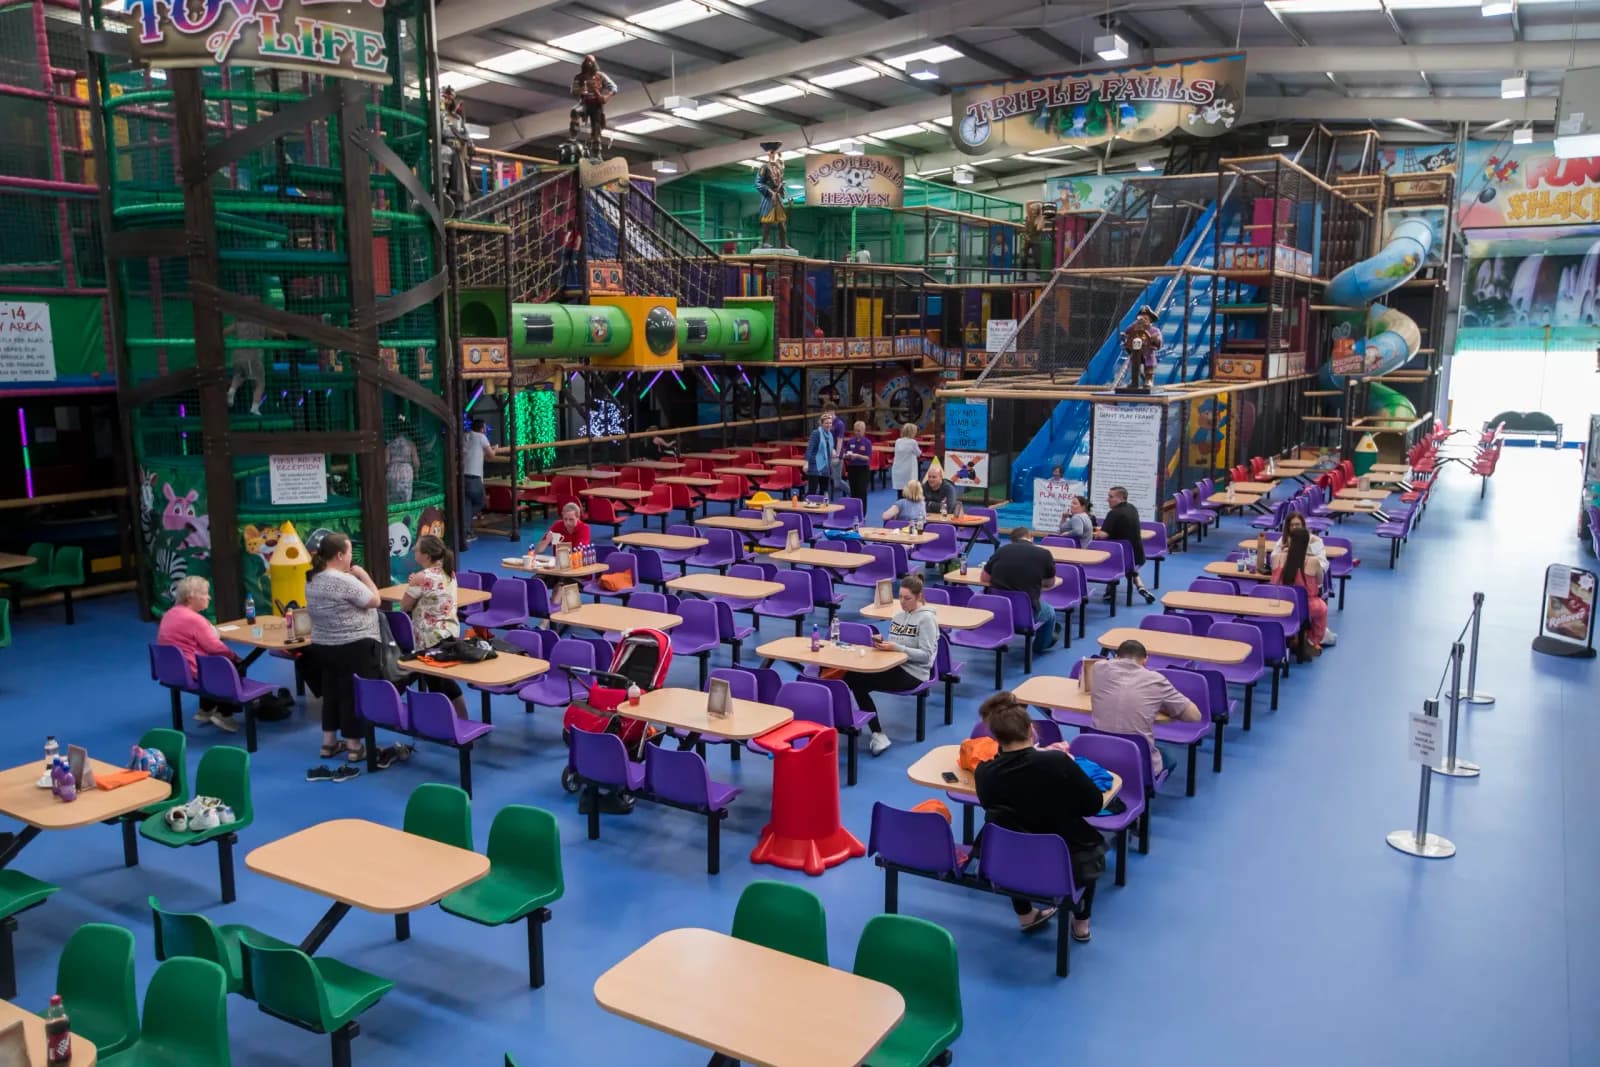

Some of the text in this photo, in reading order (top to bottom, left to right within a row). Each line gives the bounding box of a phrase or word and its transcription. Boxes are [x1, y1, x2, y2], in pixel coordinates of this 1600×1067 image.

[206, 16, 255, 62] of
[256, 12, 389, 73] LIFE
[967, 77, 1217, 127] TRIPLE FALLS
[807, 157, 904, 188] FOOTBALL
[820, 192, 890, 206] HEAVEN
[9, 322, 43, 332] AREA
[1047, 481, 1070, 492] 4-14
[1040, 490, 1055, 498] PLAY
